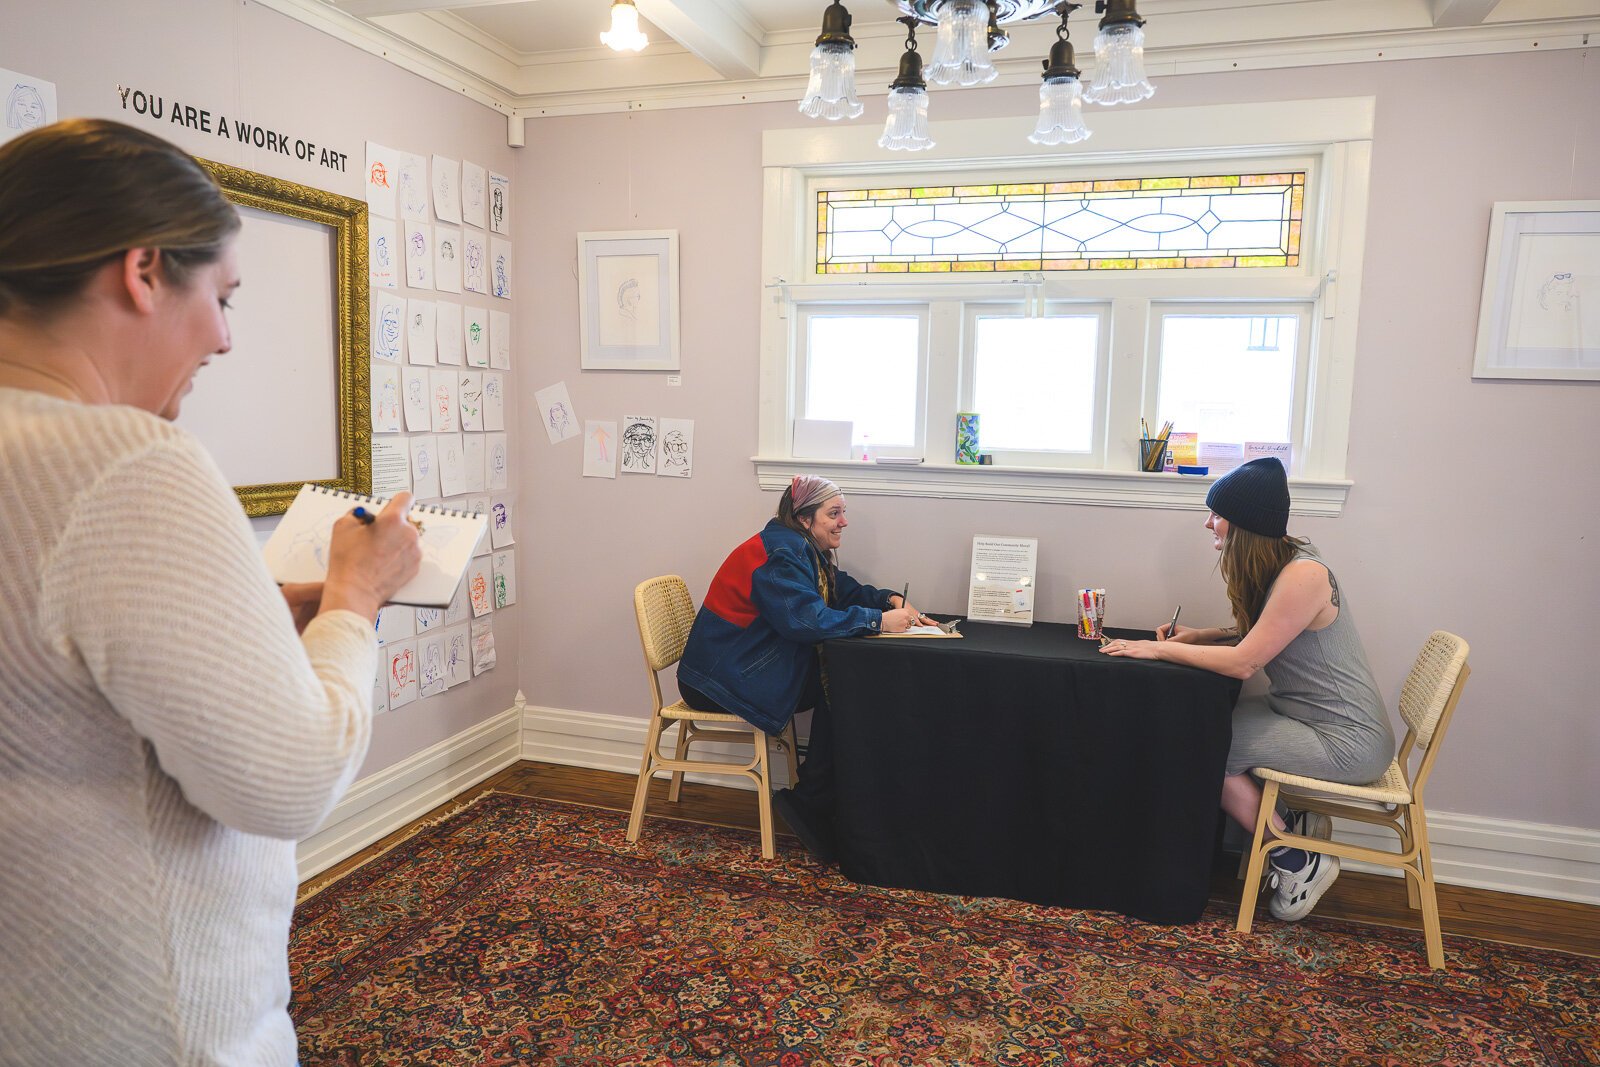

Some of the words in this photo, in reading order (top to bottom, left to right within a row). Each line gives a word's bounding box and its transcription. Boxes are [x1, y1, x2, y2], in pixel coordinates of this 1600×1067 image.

[116, 83, 163, 119] YOU
[170, 102, 212, 134] ARE
[217, 116, 230, 139] A
[235, 120, 291, 156] WORK
[295, 139, 316, 162] OF
[320, 147, 348, 173] ART
